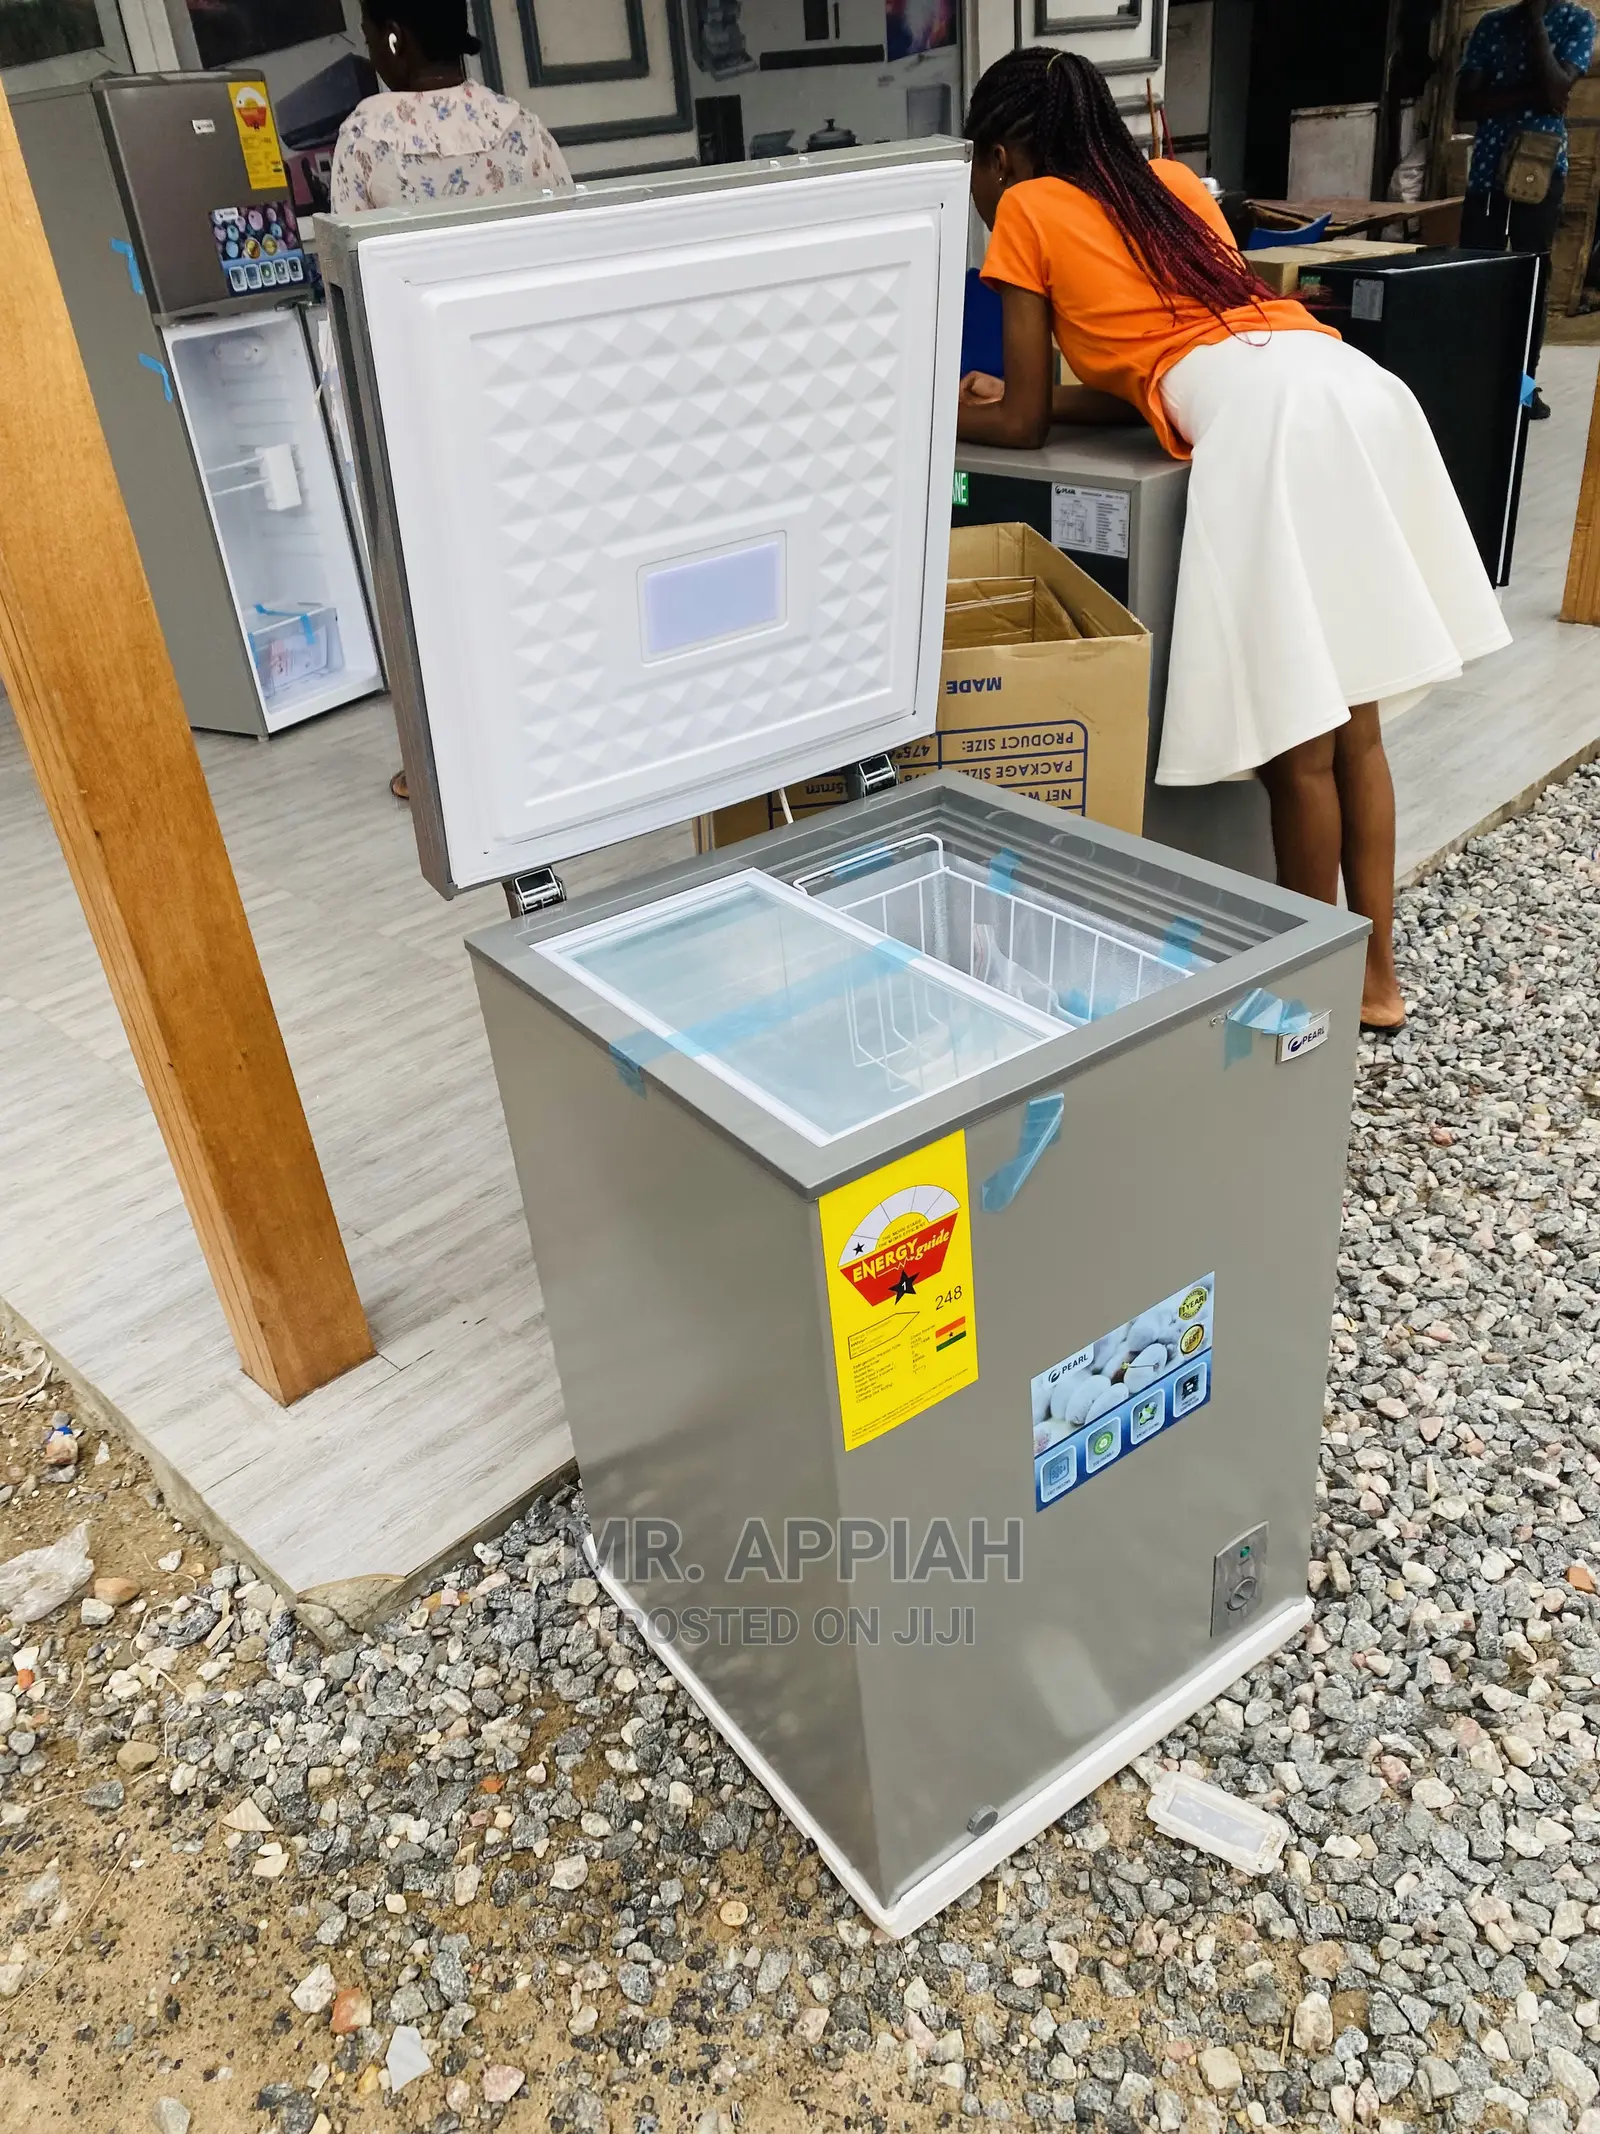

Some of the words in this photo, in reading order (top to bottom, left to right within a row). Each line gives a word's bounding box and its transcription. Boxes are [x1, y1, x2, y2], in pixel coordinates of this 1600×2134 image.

[946, 676, 1002, 695] MADE
[962, 738, 996, 752] SIZE:
[1001, 732, 1073, 749] PRODUCT
[996, 760, 1073, 778] PACKAGE
[1045, 788, 1072, 802] NET
[1302, 1026, 1324, 1045] PEARL
[853, 1238, 918, 1283] ENERGY
[915, 1228, 950, 1260] guide
[901, 1281, 907, 1292] 1
[935, 1285, 963, 1311] 248
[1185, 1295, 1204, 1309] YEAR
[1062, 1353, 1089, 1375] PEARL
